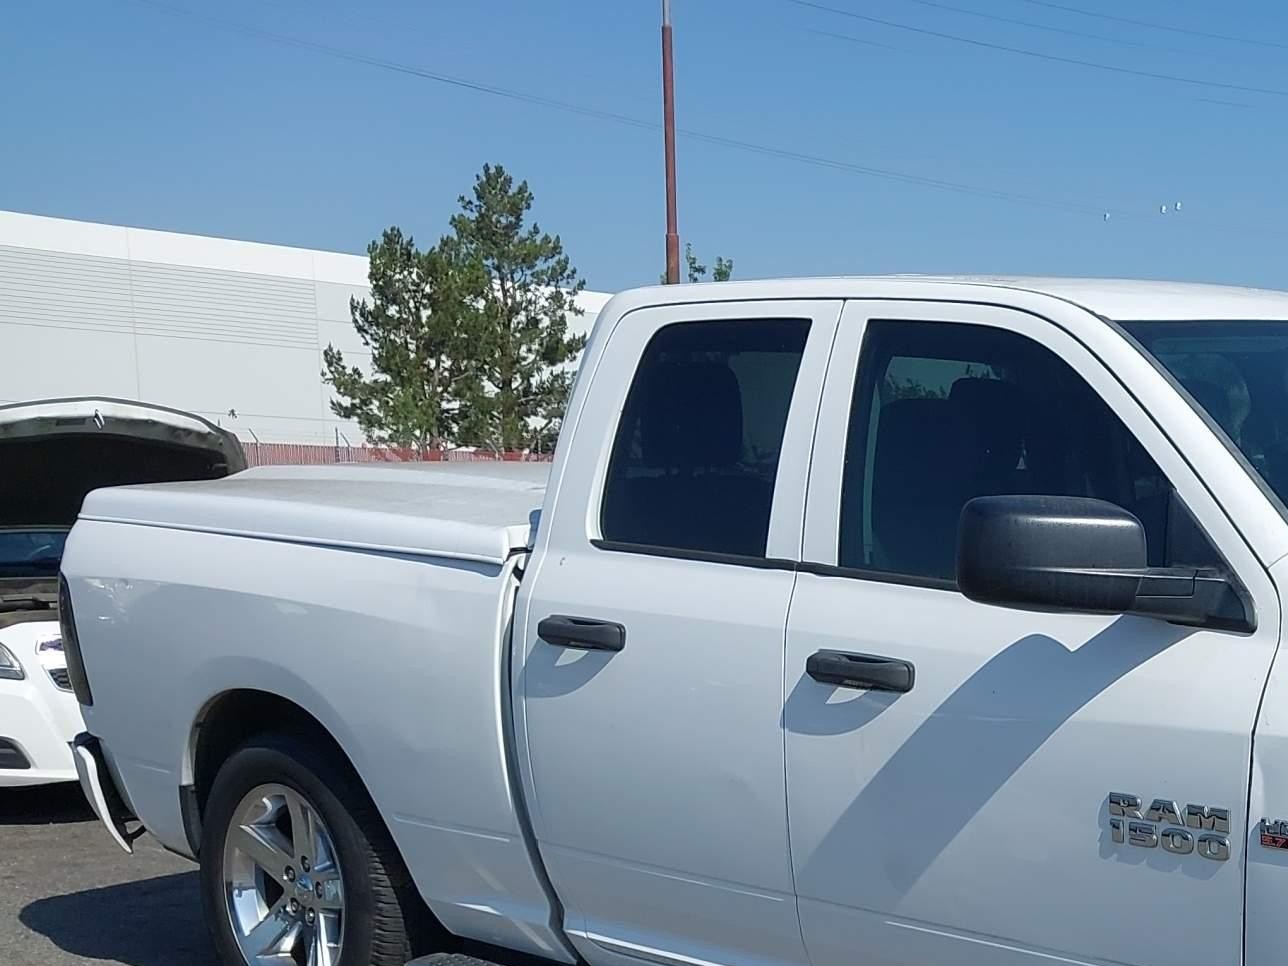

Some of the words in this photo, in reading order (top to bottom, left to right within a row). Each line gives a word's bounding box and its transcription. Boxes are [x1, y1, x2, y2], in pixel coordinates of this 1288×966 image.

[1109, 791, 1231, 834] RAM
[1109, 818, 1231, 861] 1500
[1262, 835, 1286, 848] 5.7
